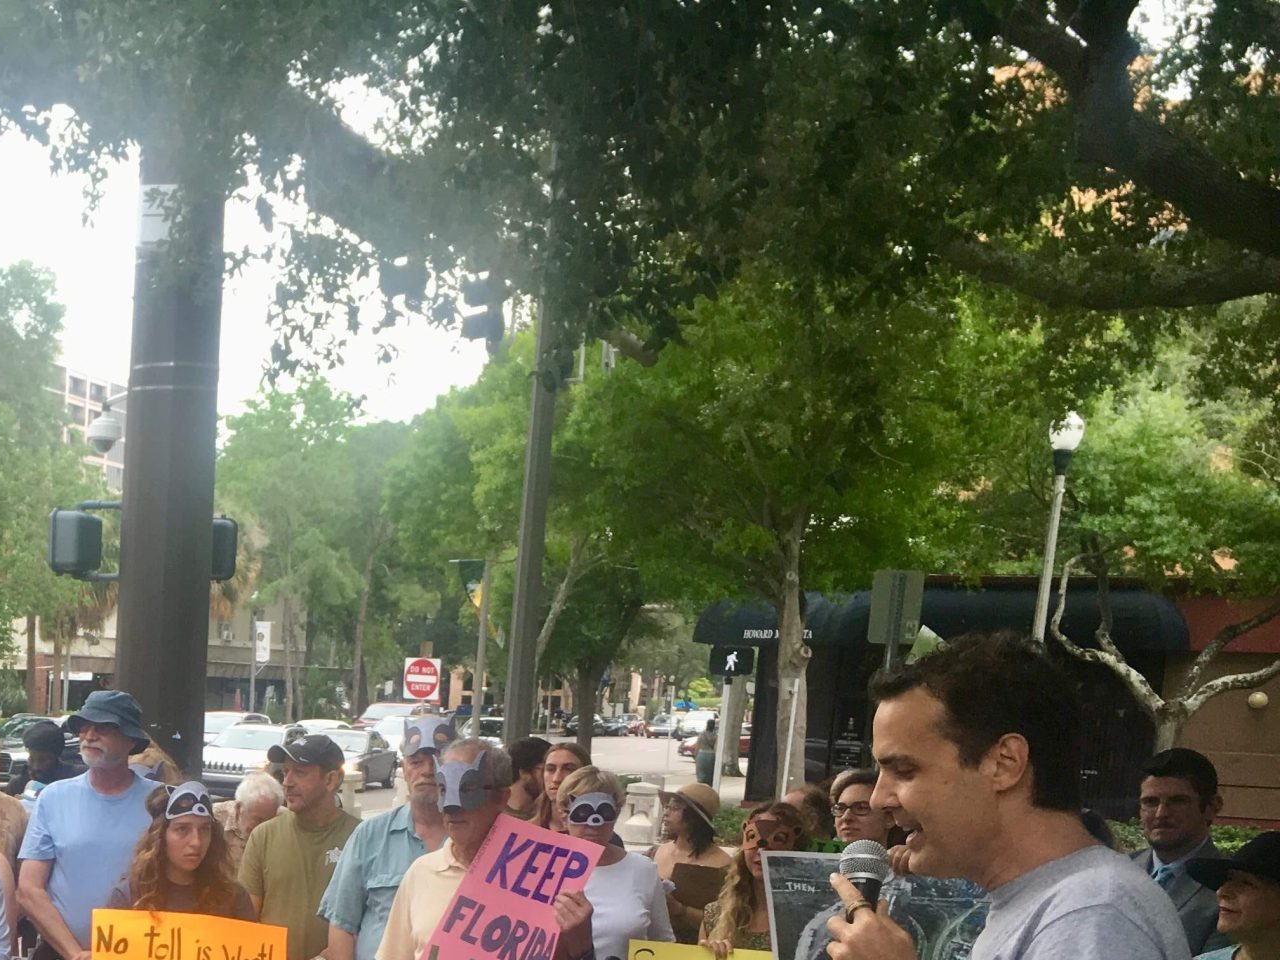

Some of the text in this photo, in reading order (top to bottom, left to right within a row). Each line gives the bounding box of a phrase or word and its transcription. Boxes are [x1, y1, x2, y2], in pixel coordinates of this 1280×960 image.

[743, 629, 774, 639] HOWARD
[411, 683, 431, 691] ENTER
[485, 832, 589, 906] KEEP
[785, 881, 817, 894] THEN
[96, 925, 129, 955] No
[144, 925, 182, 960] toll
